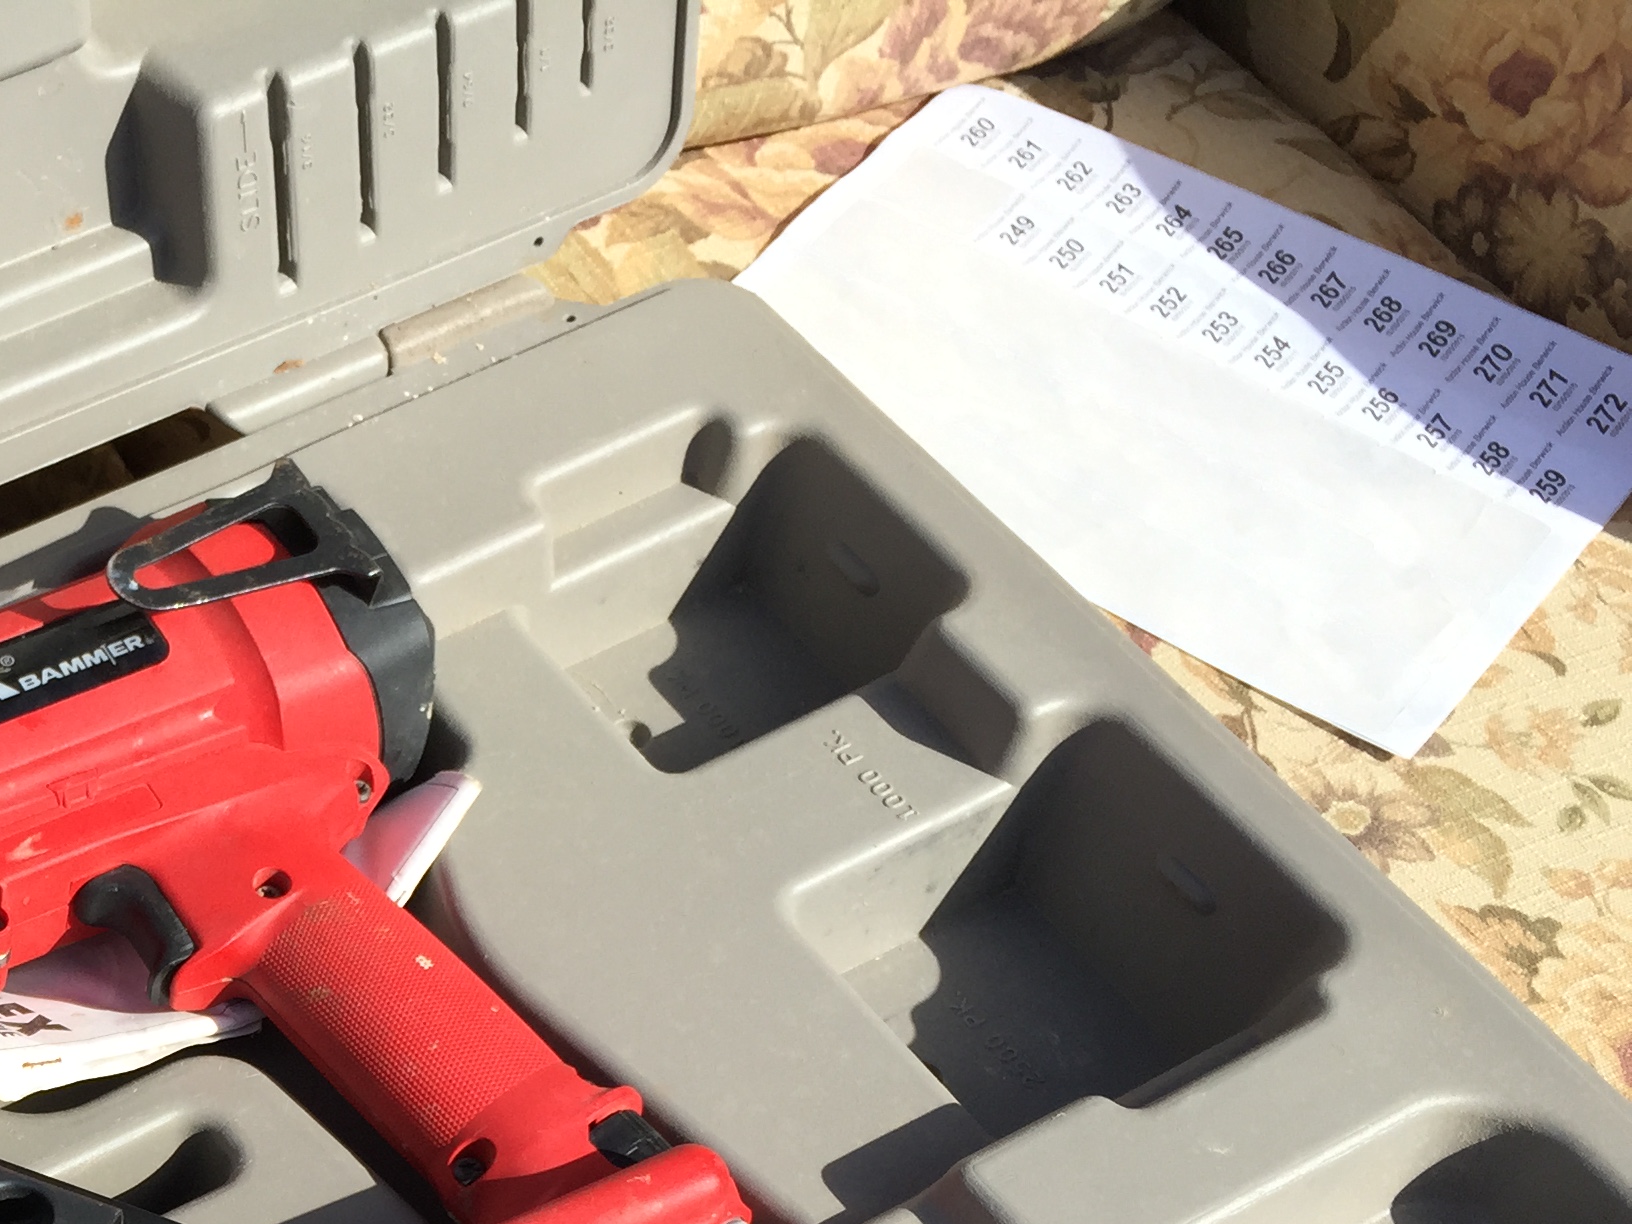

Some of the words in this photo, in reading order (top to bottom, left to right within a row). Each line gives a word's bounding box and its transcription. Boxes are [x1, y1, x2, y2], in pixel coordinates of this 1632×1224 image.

[960, 117, 995, 147] 260
[1008, 140, 1042, 169] 261
[235, 151, 261, 233] SLIDE
[1057, 161, 1093, 191] 262
[1106, 183, 1141, 214] 263
[999, 215, 1035, 245] 249
[1156, 204, 1192, 237] 264
[1048, 238, 1084, 270] 250
[1207, 226, 1243, 261] 265
[1313, 246, 1337, 274] Berwick
[1099, 263, 1134, 294] 251
[1258, 249, 1295, 285] 266
[1367, 269, 1391, 297] Berwick
[1150, 286, 1187, 318] 252
[1310, 271, 1346, 309] 267
[1421, 292, 1445, 321] Berwick
[1202, 311, 1238, 343] 253
[1363, 296, 1402, 333] 268
[1476, 317, 1501, 346] Berwick
[1254, 335, 1291, 369] 254
[1418, 320, 1457, 358] 269
[1532, 341, 1557, 370] Berwick
[1307, 361, 1344, 395] 255
[1473, 343, 1513, 383] 270
[1589, 365, 1614, 395] Berwick
[1361, 387, 1399, 422] 256
[1529, 368, 1568, 408] 271
[1417, 413, 1451, 448] 257
[1473, 415, 1496, 442] Berwick
[1586, 393, 1628, 435] 272
[1473, 441, 1510, 476] 258
[1529, 469, 1566, 503] 259
[19, 635, 146, 692] BAMMER
[823, 729, 863, 767] PK.
[857, 768, 920, 821] 1000
